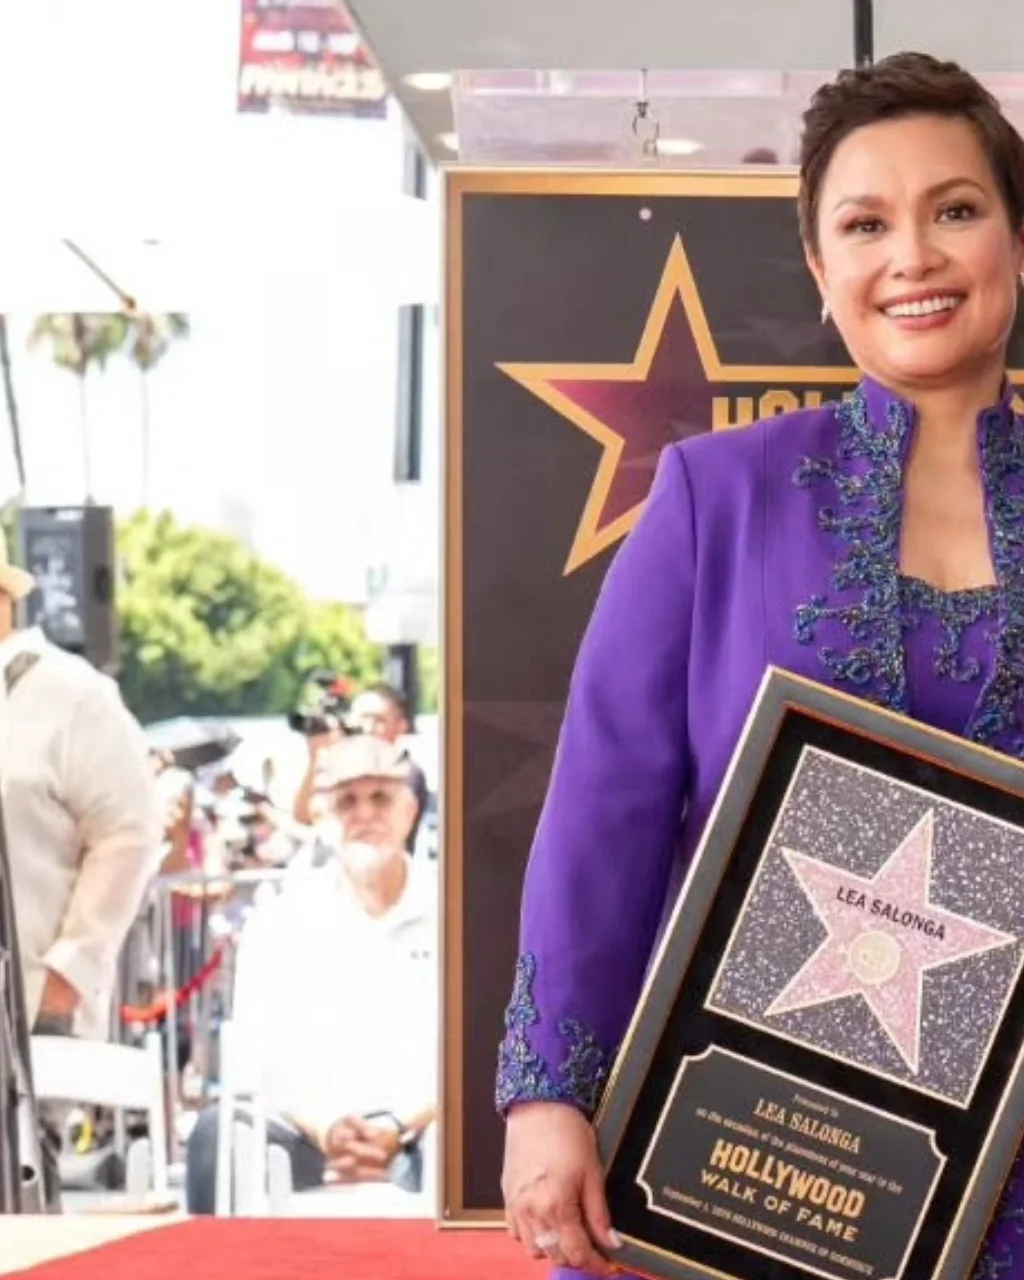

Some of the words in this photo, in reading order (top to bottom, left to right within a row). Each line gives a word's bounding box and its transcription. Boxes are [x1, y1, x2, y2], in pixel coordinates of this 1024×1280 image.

[837, 885, 866, 908] LEA
[870, 898, 946, 940] SALONGA
[753, 1097, 786, 1126] LEA
[789, 1112, 861, 1154] SALONGA
[700, 1169, 759, 1204] WALK
[763, 1195, 791, 1215] OF
[796, 1206, 859, 1242] FAME
[710, 1137, 866, 1218] HOLLYWOOD
